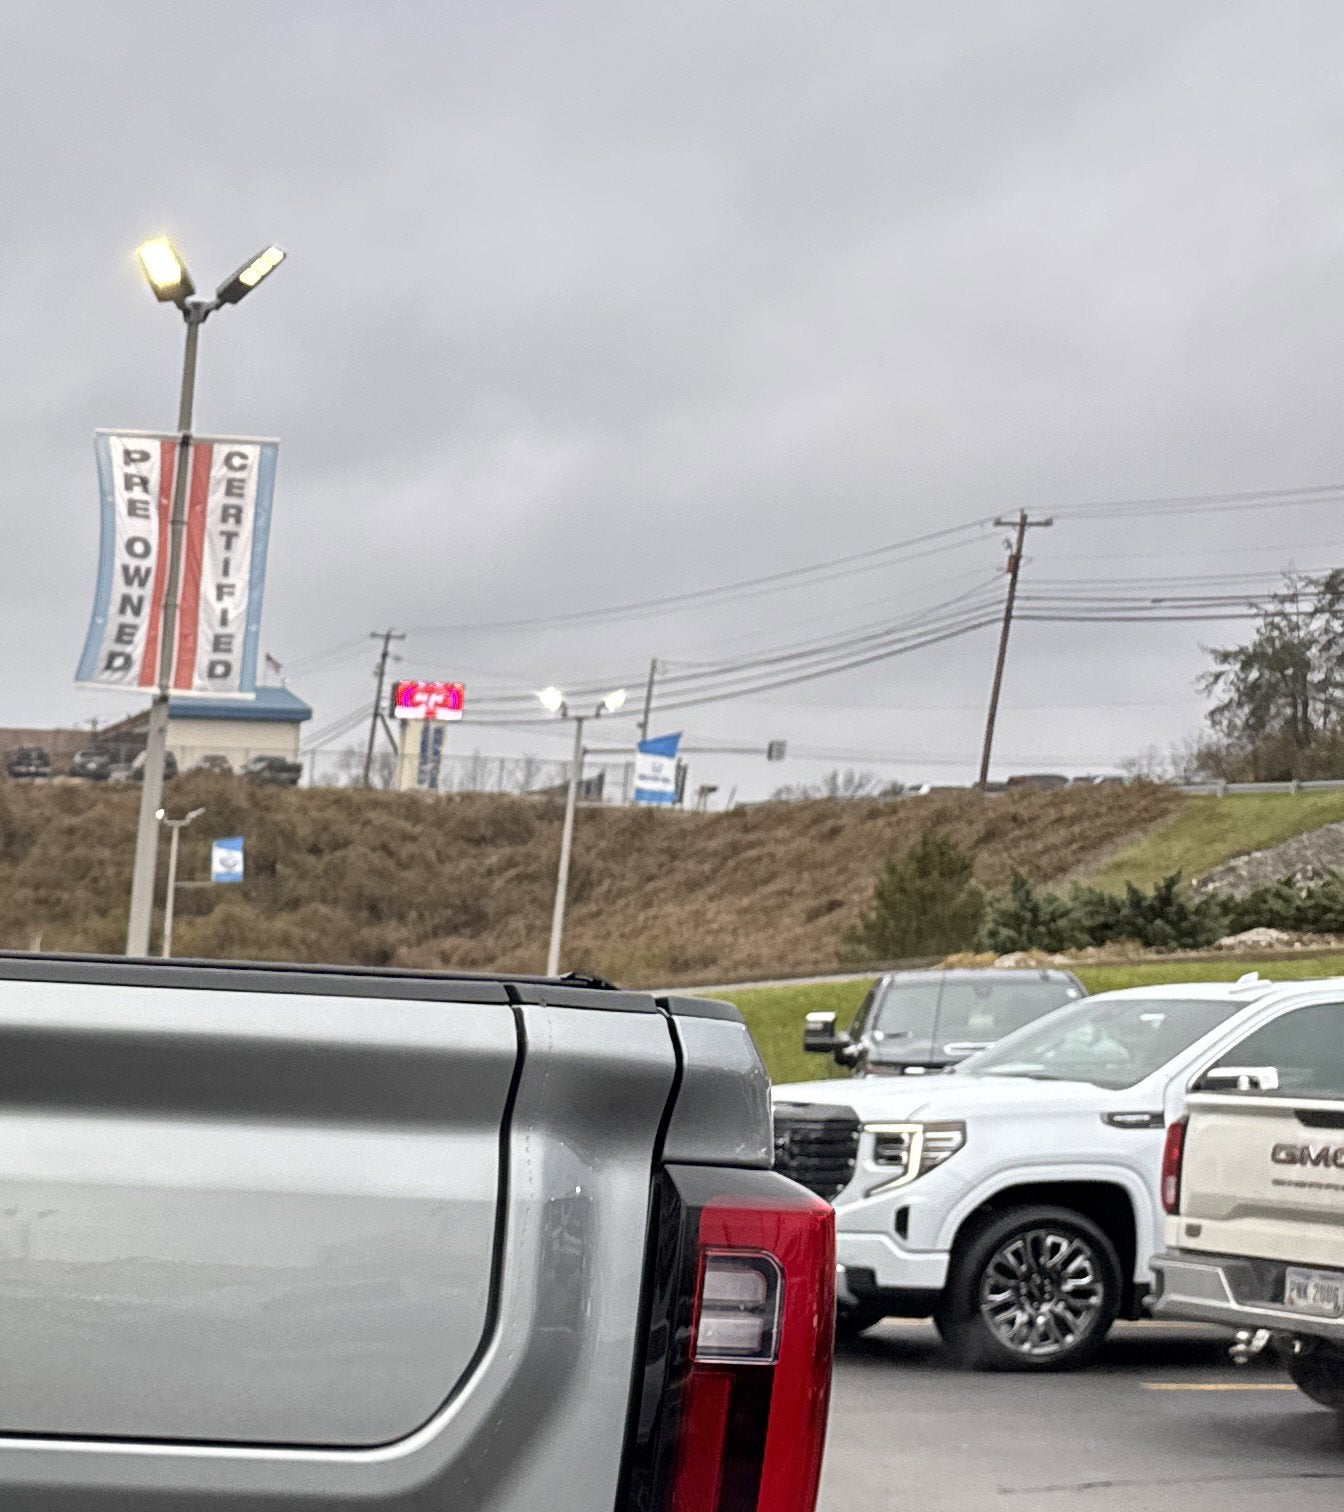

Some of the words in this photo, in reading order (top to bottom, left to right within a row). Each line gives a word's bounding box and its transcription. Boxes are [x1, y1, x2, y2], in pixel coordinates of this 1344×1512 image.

[122, 449, 152, 520] PRE
[103, 536, 152, 672] OWNED
[207, 451, 249, 680] CERTIFIED
